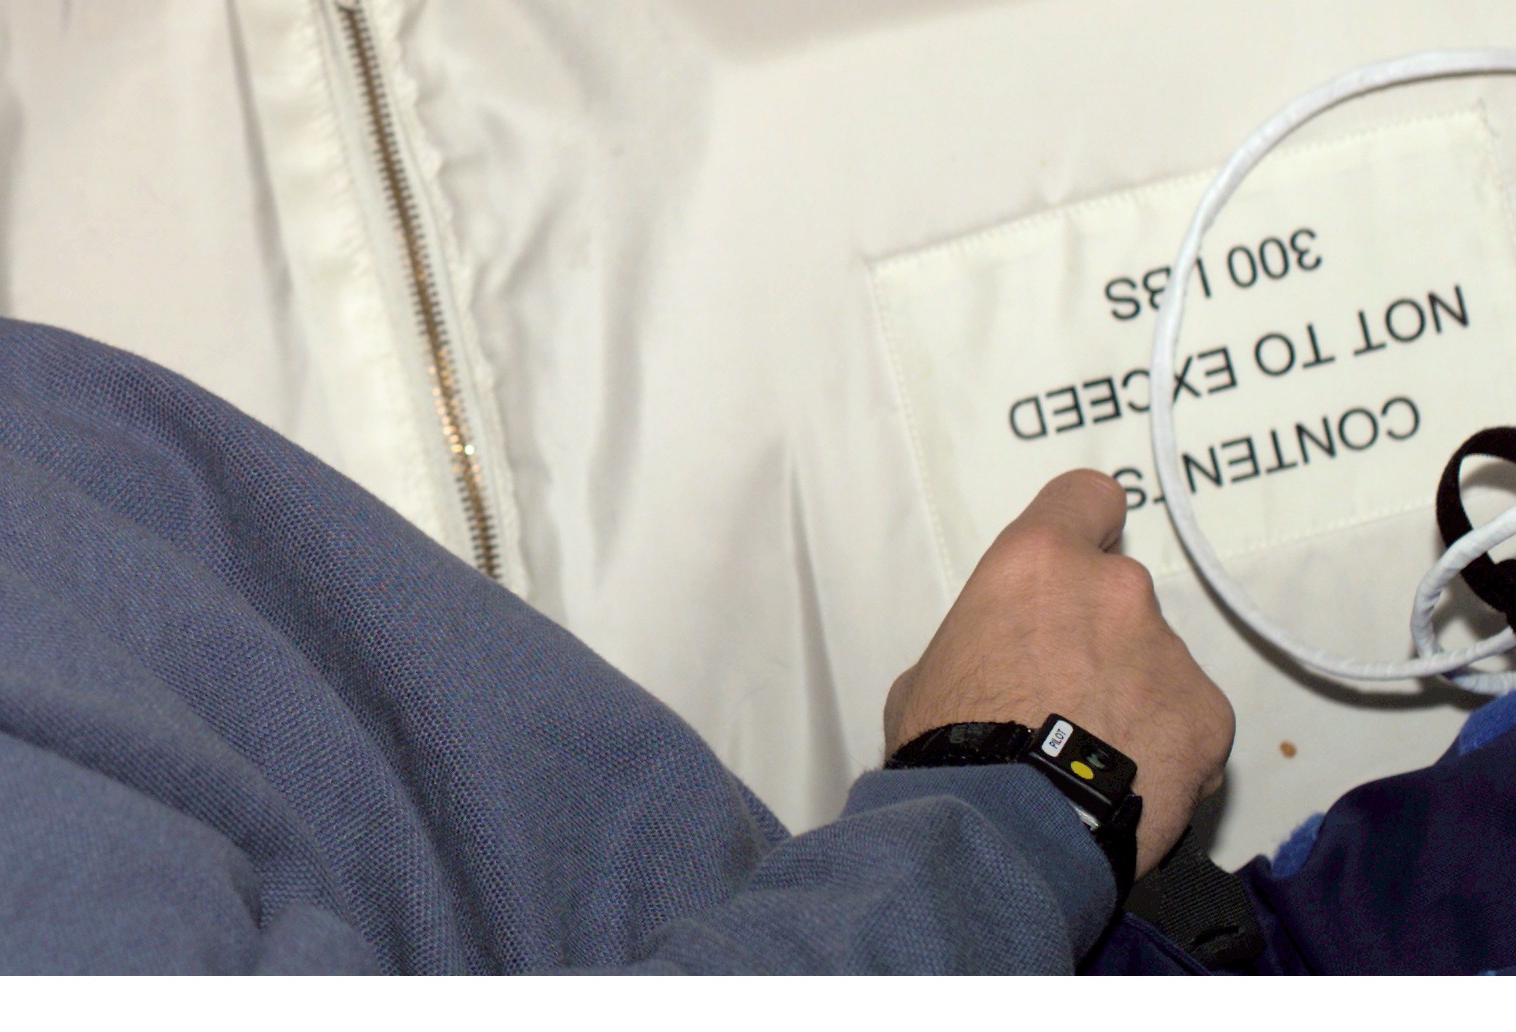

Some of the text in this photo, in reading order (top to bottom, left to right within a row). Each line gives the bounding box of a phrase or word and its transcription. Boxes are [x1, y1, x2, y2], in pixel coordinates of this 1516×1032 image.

[1226, 229, 1322, 288] 300
[1009, 285, 1469, 440] NOT TO EXCEED
[1113, 396, 1421, 510] CONTENS
[1049, 728, 1067, 750] PILOT
